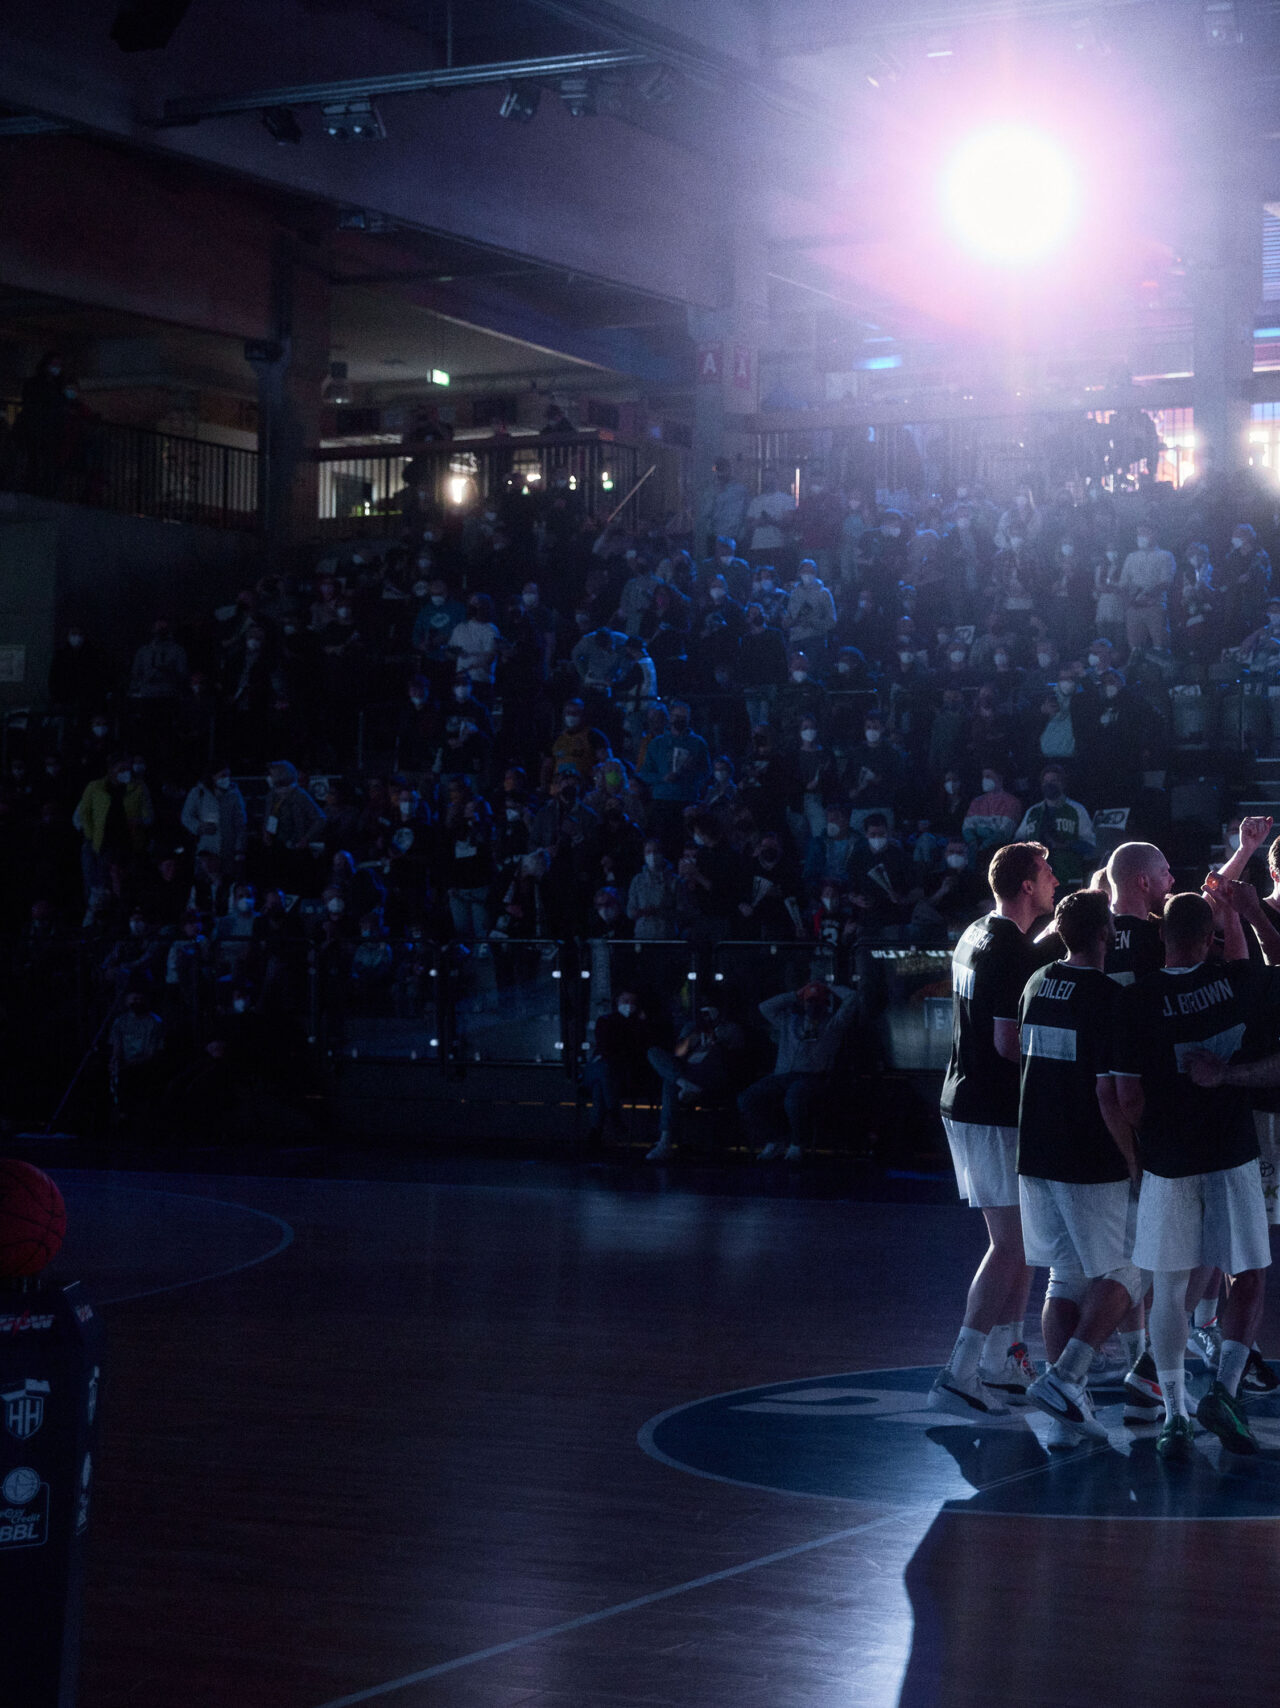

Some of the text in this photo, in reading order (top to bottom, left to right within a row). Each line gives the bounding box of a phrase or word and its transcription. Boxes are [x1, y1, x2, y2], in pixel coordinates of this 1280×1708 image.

[703, 352, 716, 374] A
[1162, 977, 1234, 1017] J. BROWN
[0, 1523, 39, 1542] BBL
